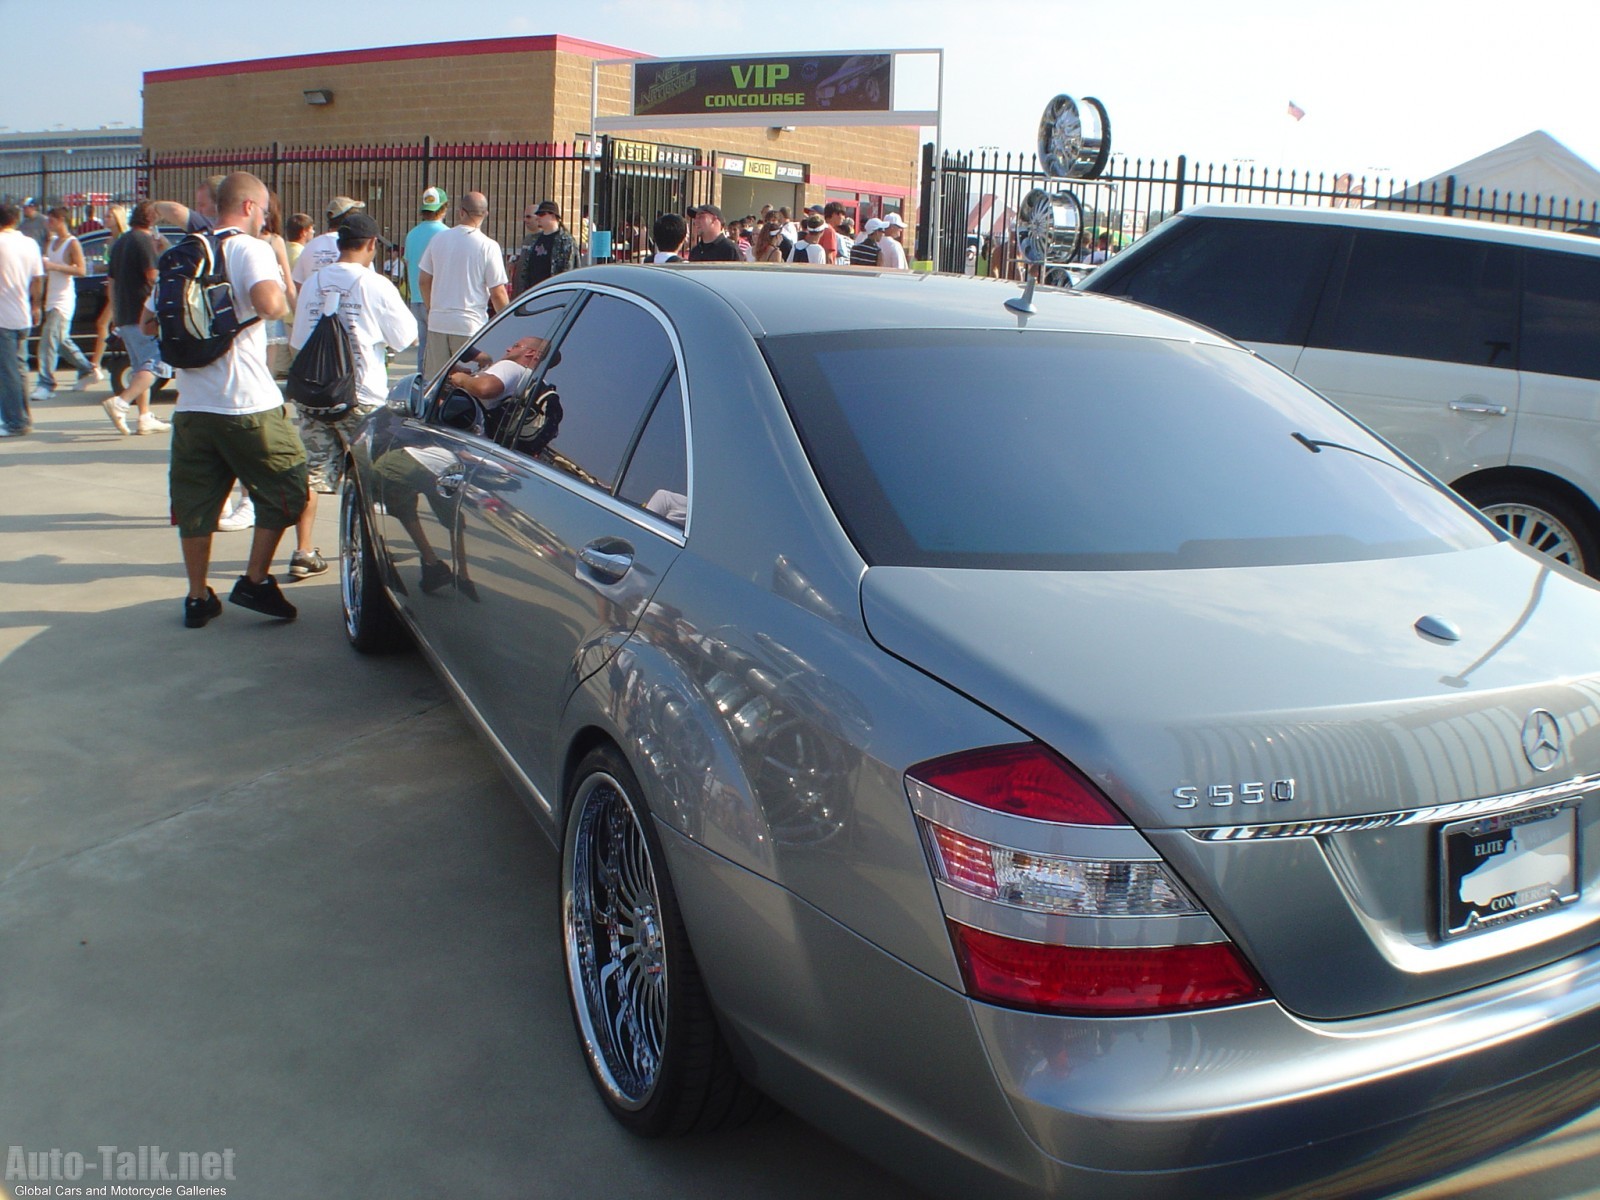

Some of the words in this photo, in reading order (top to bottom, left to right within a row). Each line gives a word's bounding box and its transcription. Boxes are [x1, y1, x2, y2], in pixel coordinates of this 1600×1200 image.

[730, 63, 790, 89] VIP
[704, 92, 806, 108] CONCOURSE
[749, 161, 772, 175] NEXTEL
[1173, 786, 1199, 809] S
[1207, 778, 1295, 807] 550
[1474, 840, 1504, 857] ELITE
